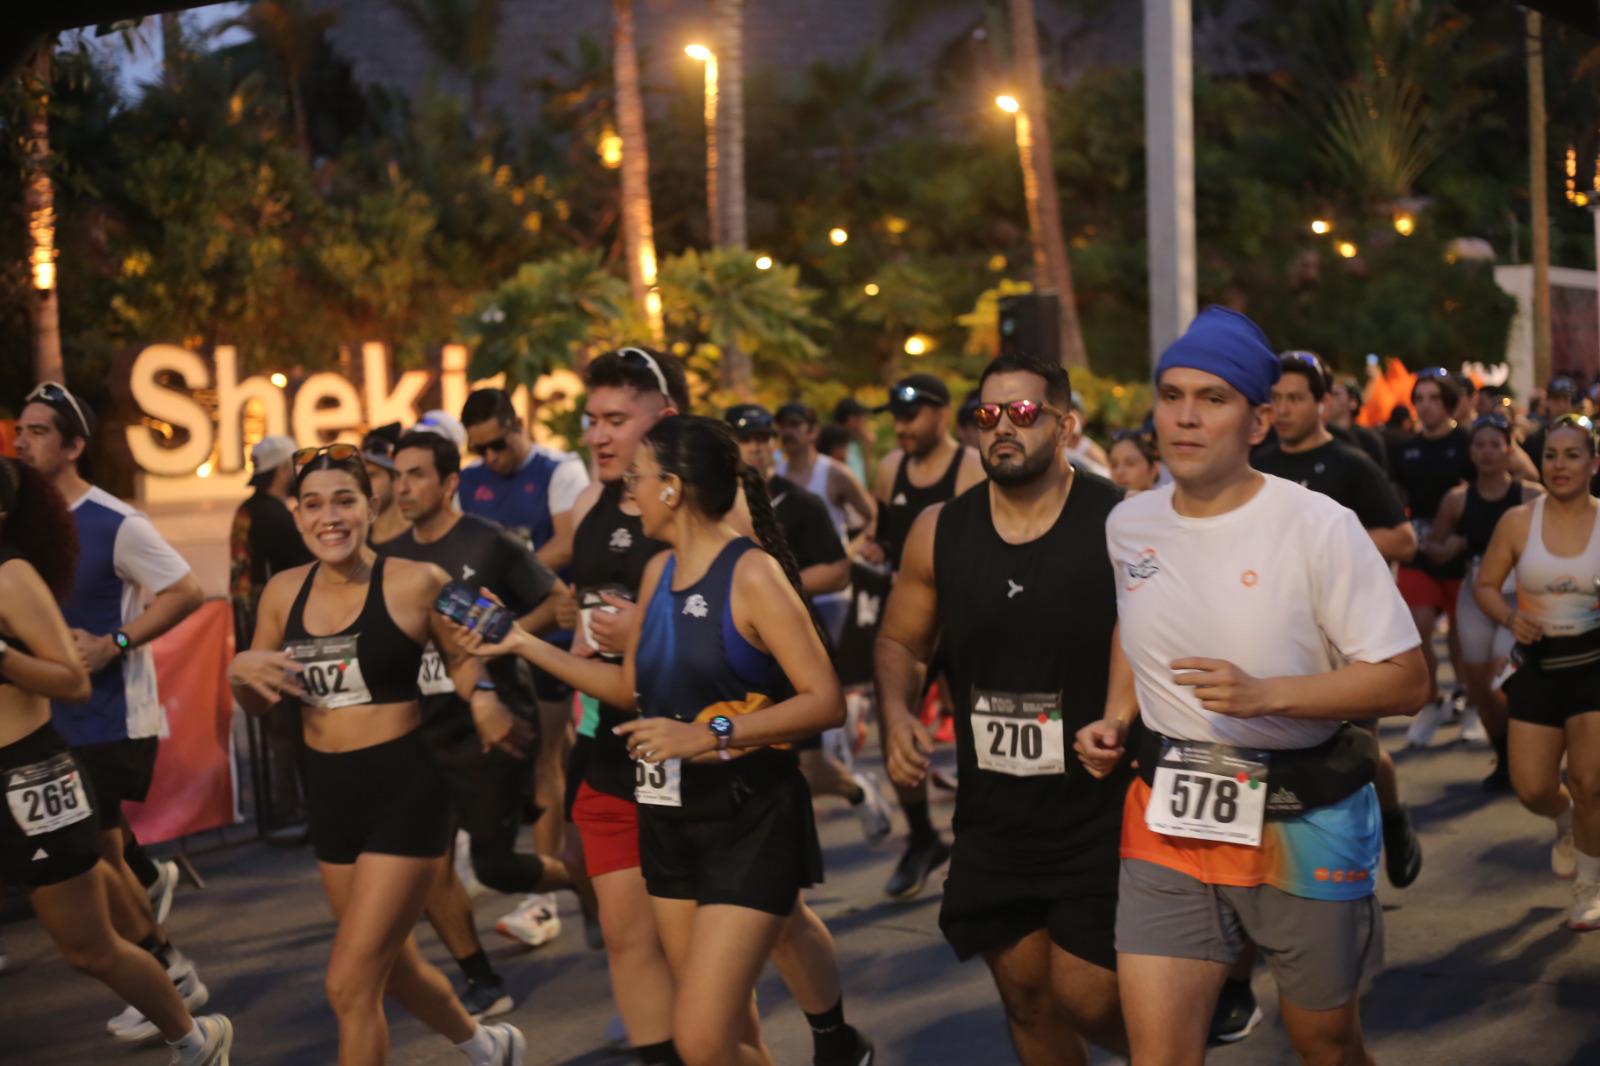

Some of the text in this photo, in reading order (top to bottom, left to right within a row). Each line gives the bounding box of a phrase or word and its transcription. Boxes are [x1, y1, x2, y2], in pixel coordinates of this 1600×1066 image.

[986, 721, 1042, 760] 270
[22, 779, 79, 822] 265
[1170, 773, 1239, 823] 578
